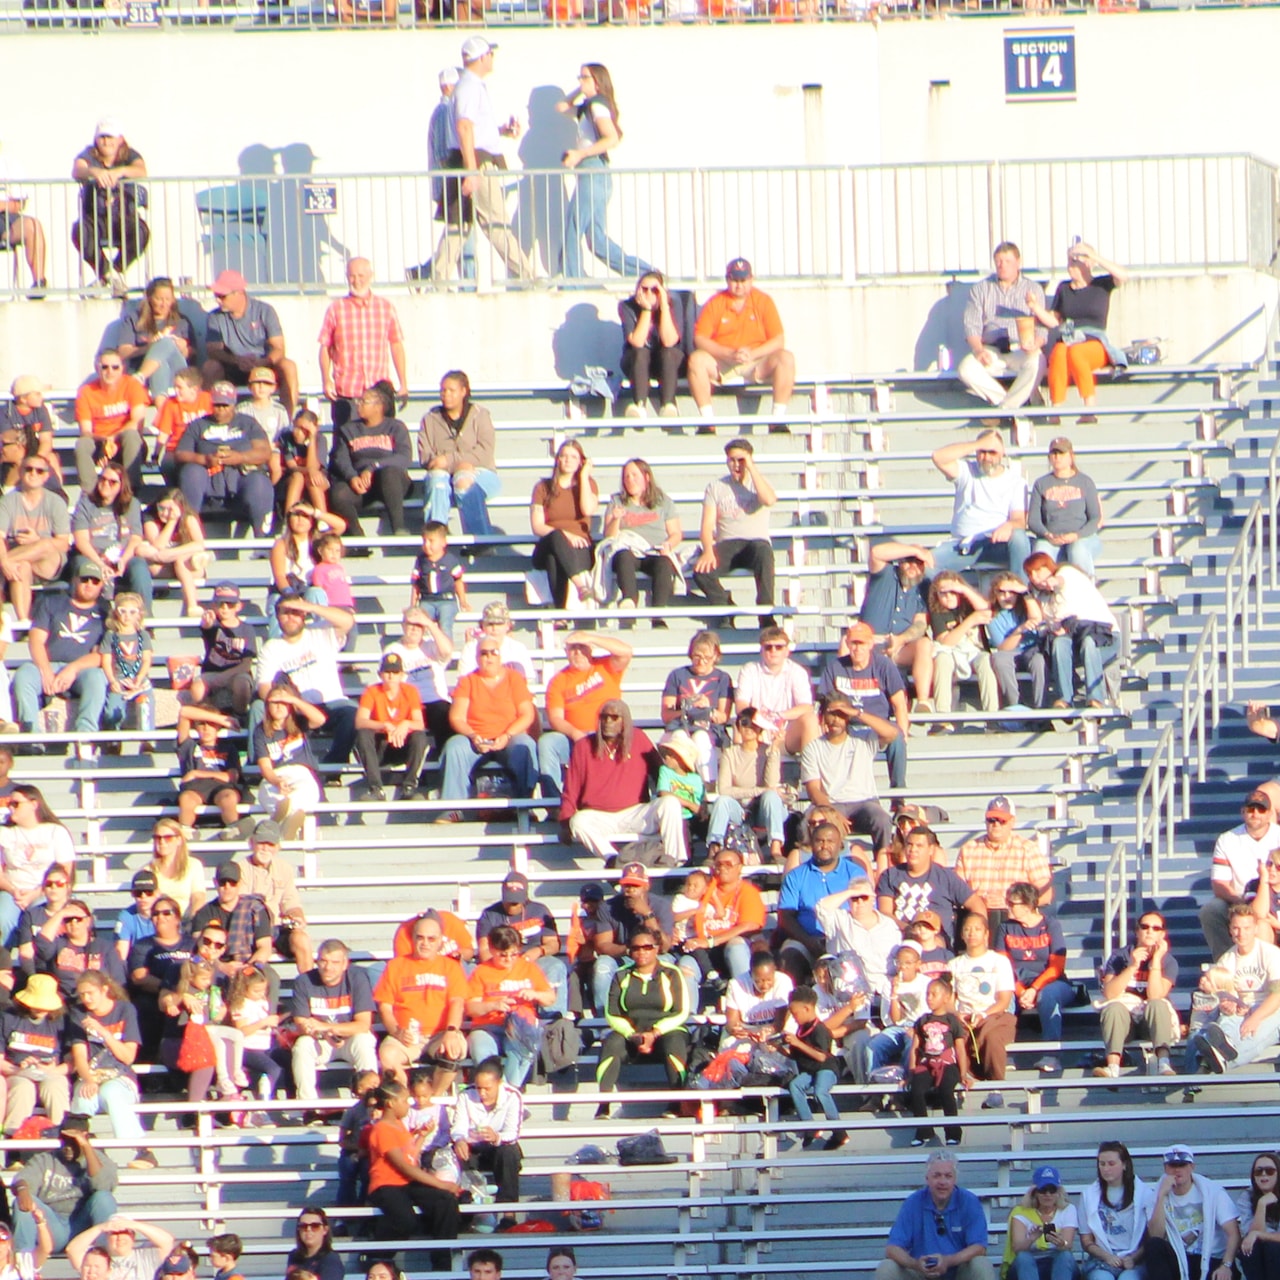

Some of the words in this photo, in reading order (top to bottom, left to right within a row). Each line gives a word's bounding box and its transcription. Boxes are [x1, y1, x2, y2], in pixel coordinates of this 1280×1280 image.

[129, 8, 155, 22] 313
[1012, 42, 1068, 55] SECTION
[1017, 55, 1063, 88] 114
